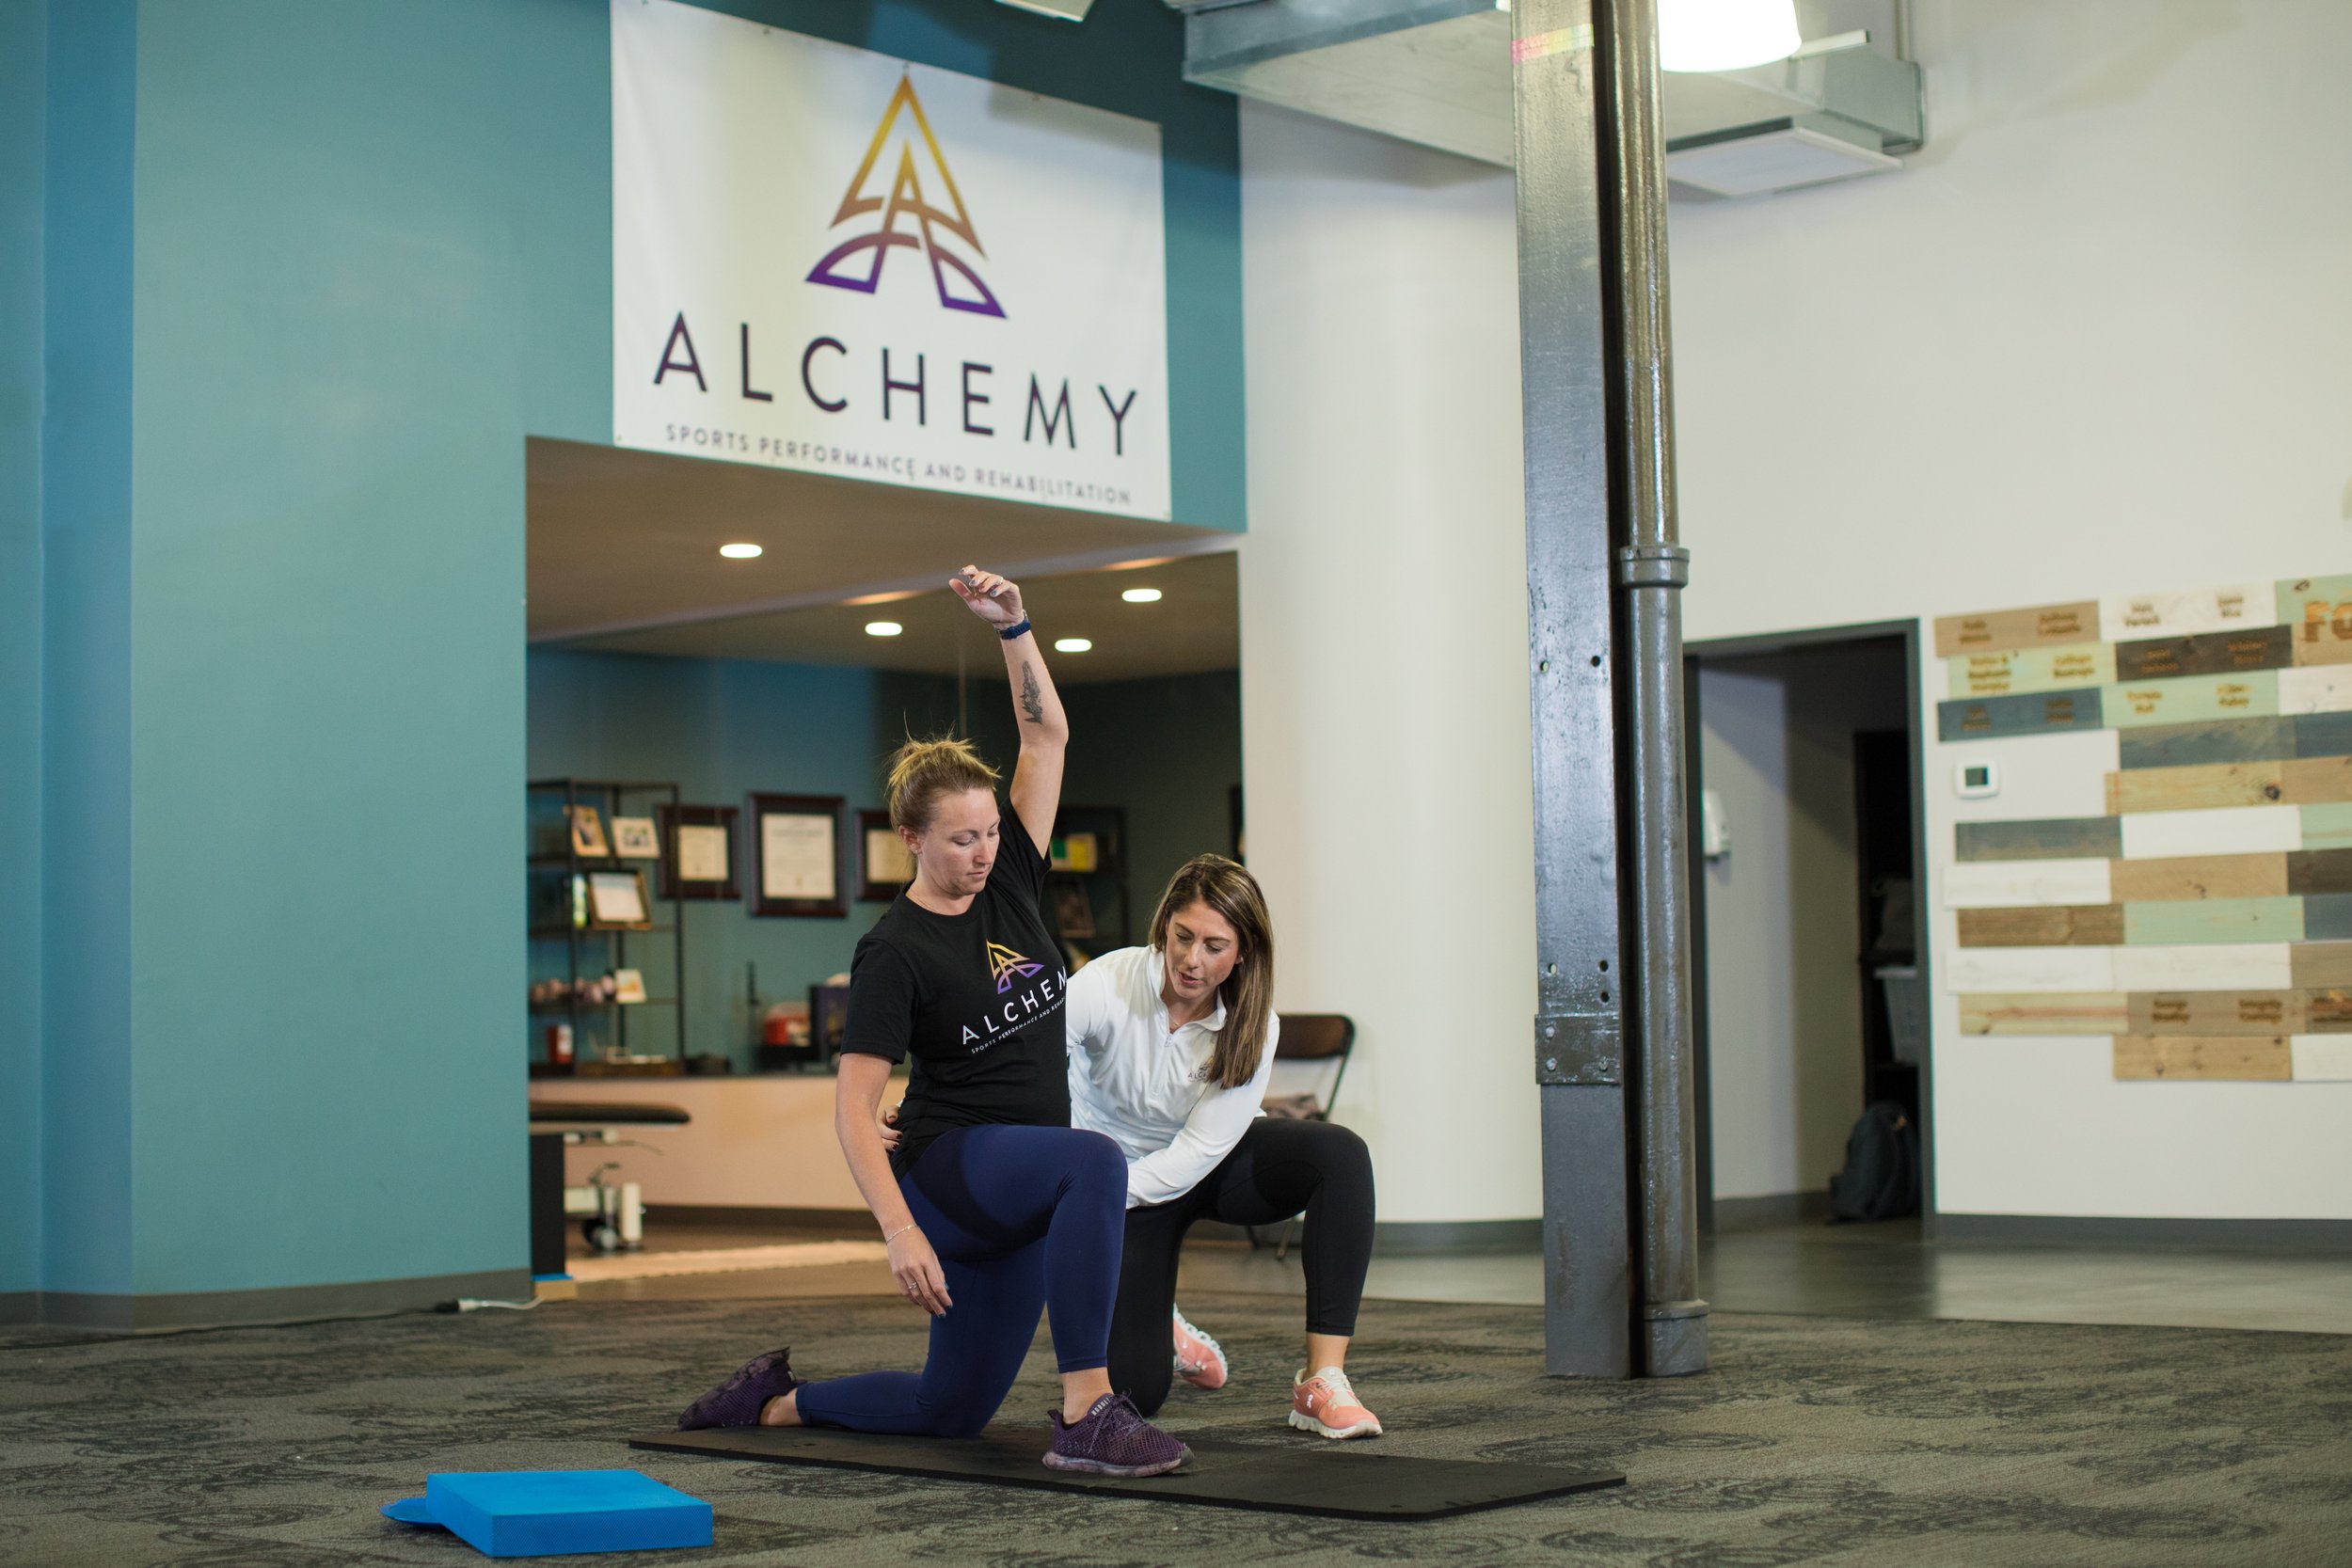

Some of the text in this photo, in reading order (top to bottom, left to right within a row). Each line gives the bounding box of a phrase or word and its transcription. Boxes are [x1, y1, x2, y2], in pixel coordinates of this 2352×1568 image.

[653, 311, 1137, 457] ALCHEMY
[666, 423, 1131, 505] SPORTS PERFORMANCE AND REHABILITATION
[971, 1039, 996, 1054] SPORTS
[998, 1016, 1038, 1041] PERFORMANCE
[1039, 1009, 1051, 1019] AND
